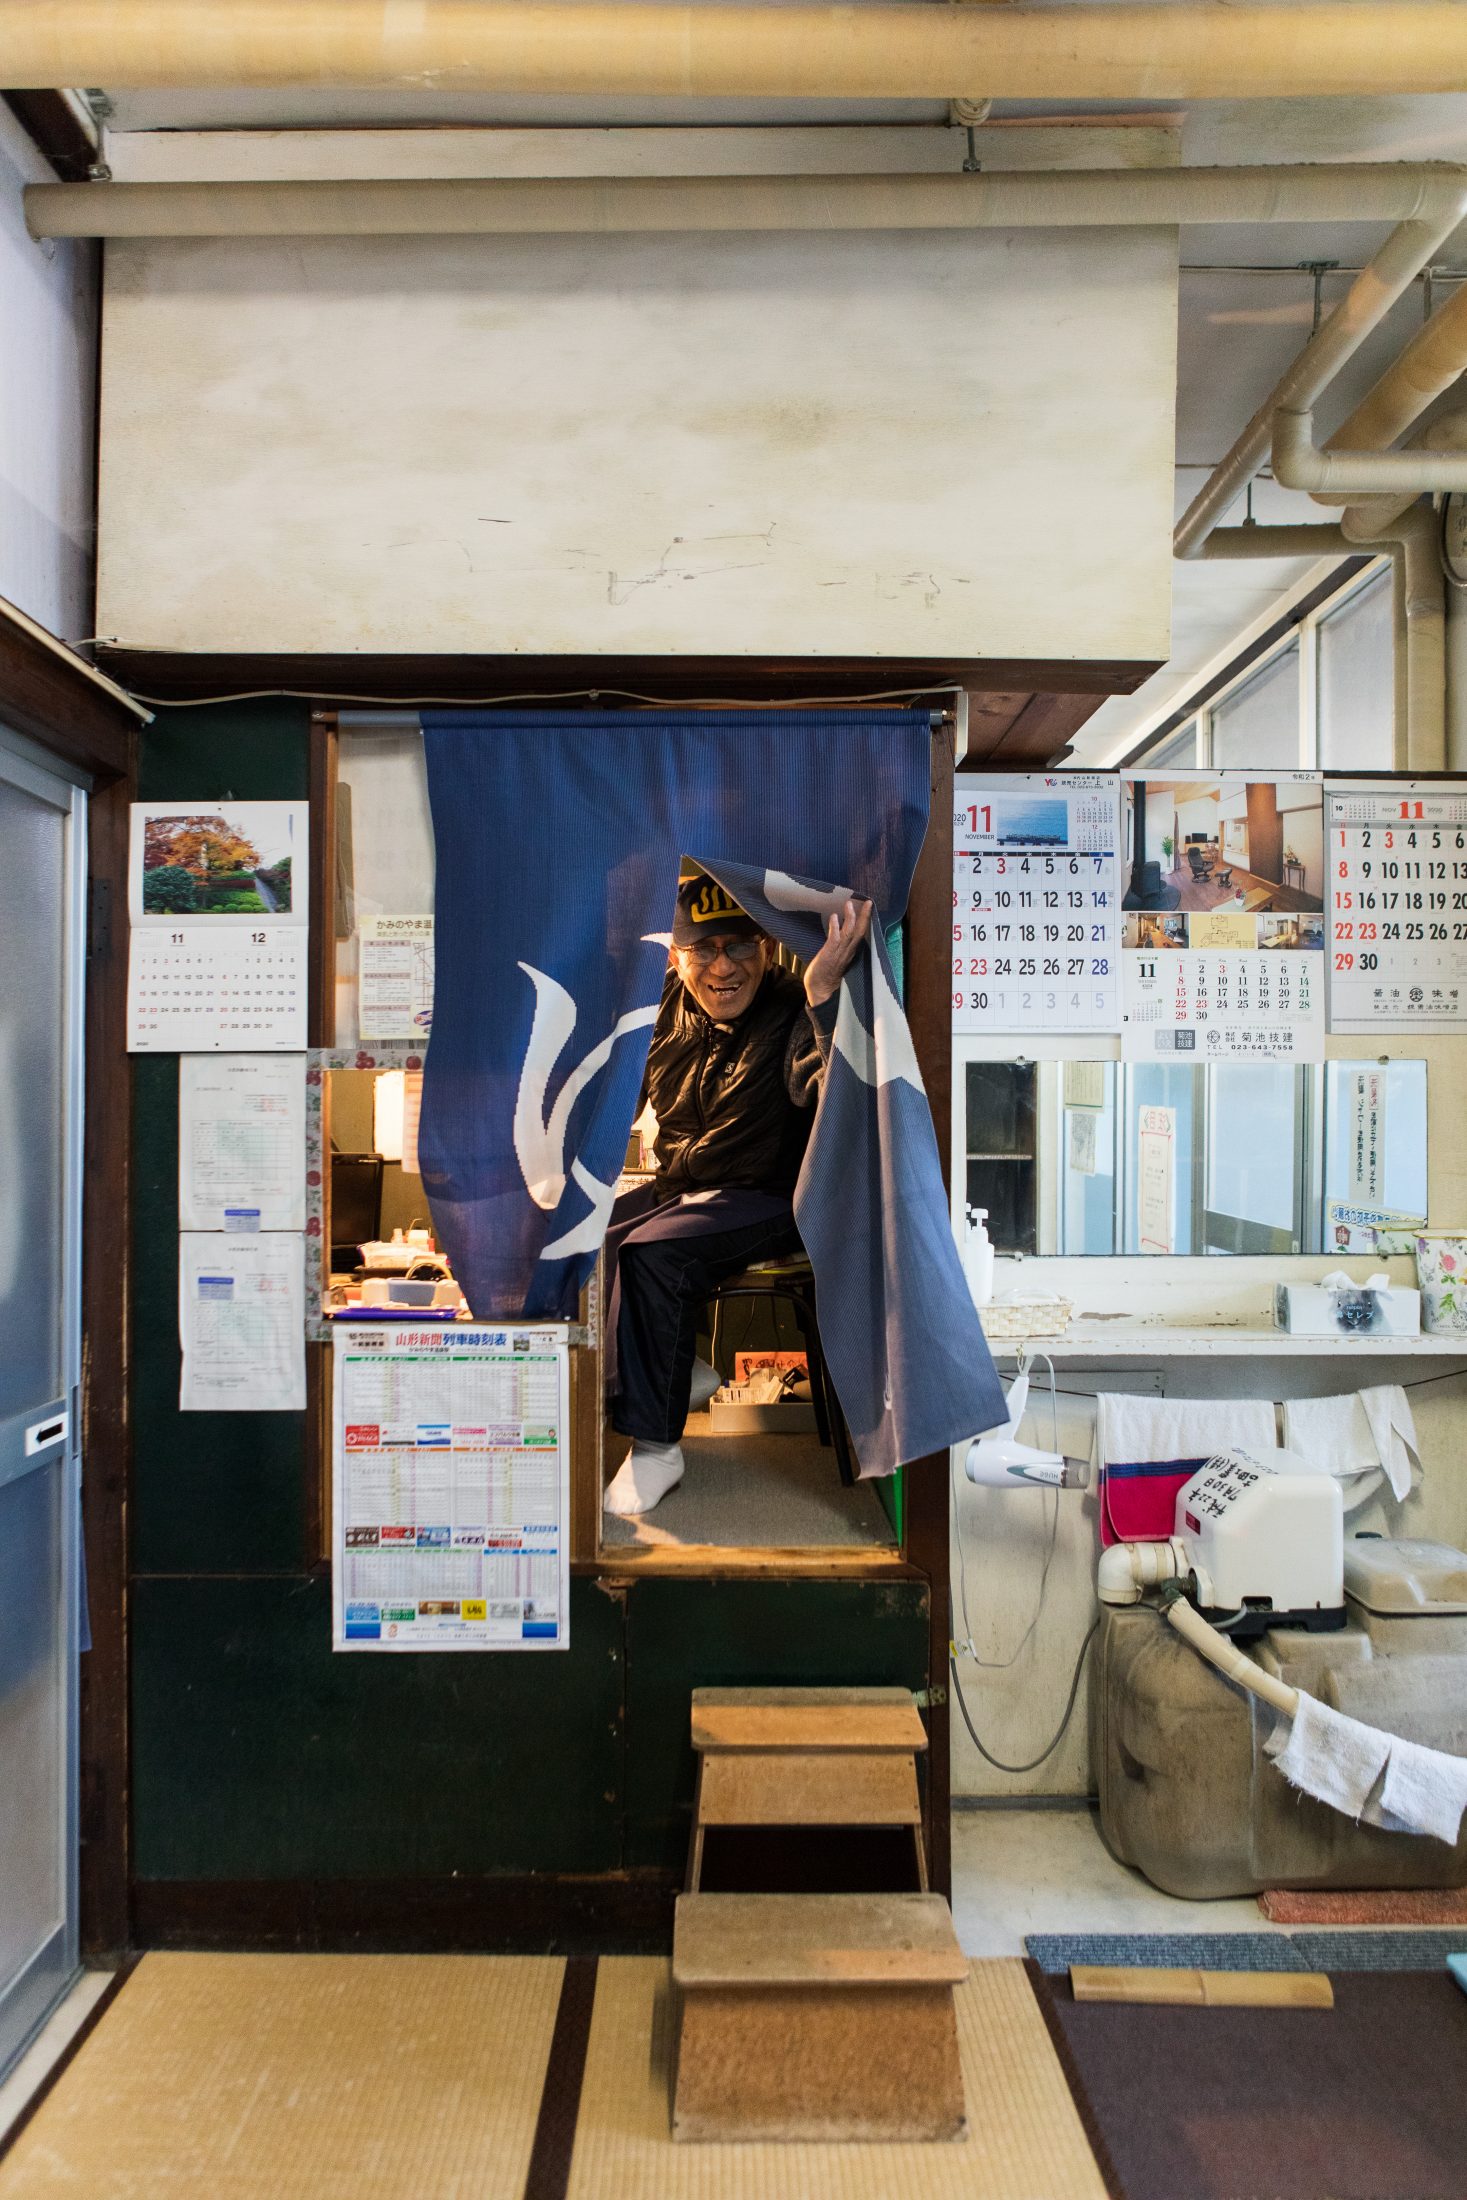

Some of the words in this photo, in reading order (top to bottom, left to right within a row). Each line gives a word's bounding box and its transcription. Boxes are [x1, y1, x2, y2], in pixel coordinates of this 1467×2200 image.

[967, 805, 990, 832] 11
[1399, 802, 1424, 819] 11
[1340, 831, 1345, 848] 1
[1362, 831, 1370, 848] 2
[1385, 831, 1393, 848] 3
[1408, 831, 1417, 848] 4
[1433, 831, 1440, 848] 5
[1456, 831, 1464, 848] 6
[973, 858, 981, 874] 2
[997, 858, 1005, 874] 3
[1021, 858, 1030, 874] 4
[1046, 858, 1054, 874] 5
[1070, 858, 1078, 874] 6
[1094, 858, 1102, 874] 7
[1339, 861, 1348, 878] 8
[1363, 862, 1371, 878] 9
[1382, 862, 1398, 879] 10
[1405, 863, 1420, 879] 11
[1429, 862, 1445, 879] 12
[973, 891, 981, 907] 9
[995, 891, 1010, 907] 10
[1019, 891, 1031, 907] 11
[1043, 891, 1058, 907] 12
[1067, 891, 1082, 908] 13
[1092, 892, 1107, 907] 14
[1336, 892, 1352, 909] 15
[1359, 892, 1375, 909] 16
[1382, 893, 1399, 909] 17
[1405, 893, 1422, 909] 18
[1429, 893, 1446, 909] 19
[171, 934, 183, 943] 11
[252, 933, 265, 942] 12
[971, 925, 986, 941] 16
[995, 925, 1010, 941] 17
[1019, 925, 1035, 941] 18
[1044, 925, 1059, 941] 19
[1067, 925, 1084, 941] 20
[1092, 925, 1105, 941] 21
[1335, 923, 1355, 939] 22
[1359, 923, 1377, 940] 23
[1382, 923, 1400, 939] 24
[1406, 923, 1424, 940] 25
[1429, 923, 1447, 940] 26
[971, 959, 987, 975] 23
[995, 959, 1011, 975] 24
[1019, 959, 1035, 975] 25
[1044, 959, 1060, 975] 26
[1068, 959, 1084, 975] 27
[1092, 959, 1108, 975] 28
[1179, 965, 1183, 973] 1
[1199, 965, 1204, 973] 2
[1220, 965, 1225, 973] 3
[1240, 965, 1245, 973] 4
[1261, 965, 1266, 973] 5
[1281, 966, 1286, 974] 6
[1302, 966, 1307, 974] 7
[1336, 953, 1353, 970] 29
[1359, 953, 1378, 970] 30
[1139, 964, 1156, 977] 11
[1178, 977, 1185, 986] 8
[1199, 977, 1204, 985] 9
[1239, 977, 1246, 985] 11
[1260, 977, 1268, 985] 12
[1280, 977, 1289, 985] 13
[971, 993, 988, 1009] 30
[999, 993, 1004, 1008] 1
[1023, 993, 1031, 1008] 2
[1047, 993, 1055, 1008] 3
[1071, 993, 1080, 1008] 4
[1096, 993, 1104, 1008] 5
[1177, 988, 1186, 998] 15
[1198, 988, 1207, 996] 16
[1218, 988, 1227, 996] 17
[1259, 989, 1268, 997] 19
[1279, 989, 1289, 997] 20
[1300, 989, 1308, 997] 21
[1176, 1000, 1186, 1008] 22
[1196, 1000, 1207, 1008] 23
[1217, 1000, 1228, 1008] 24
[1238, 1000, 1248, 1008] 25
[1258, 1000, 1269, 1008] 26
[1279, 1000, 1289, 1008] 27
[1176, 1011, 1186, 1019] 29
[1196, 1011, 1207, 1019] 30
[1242, 1032, 1293, 1043] 菊池技建
[396, 1333, 507, 1346] 山形新聞列車時刻表
